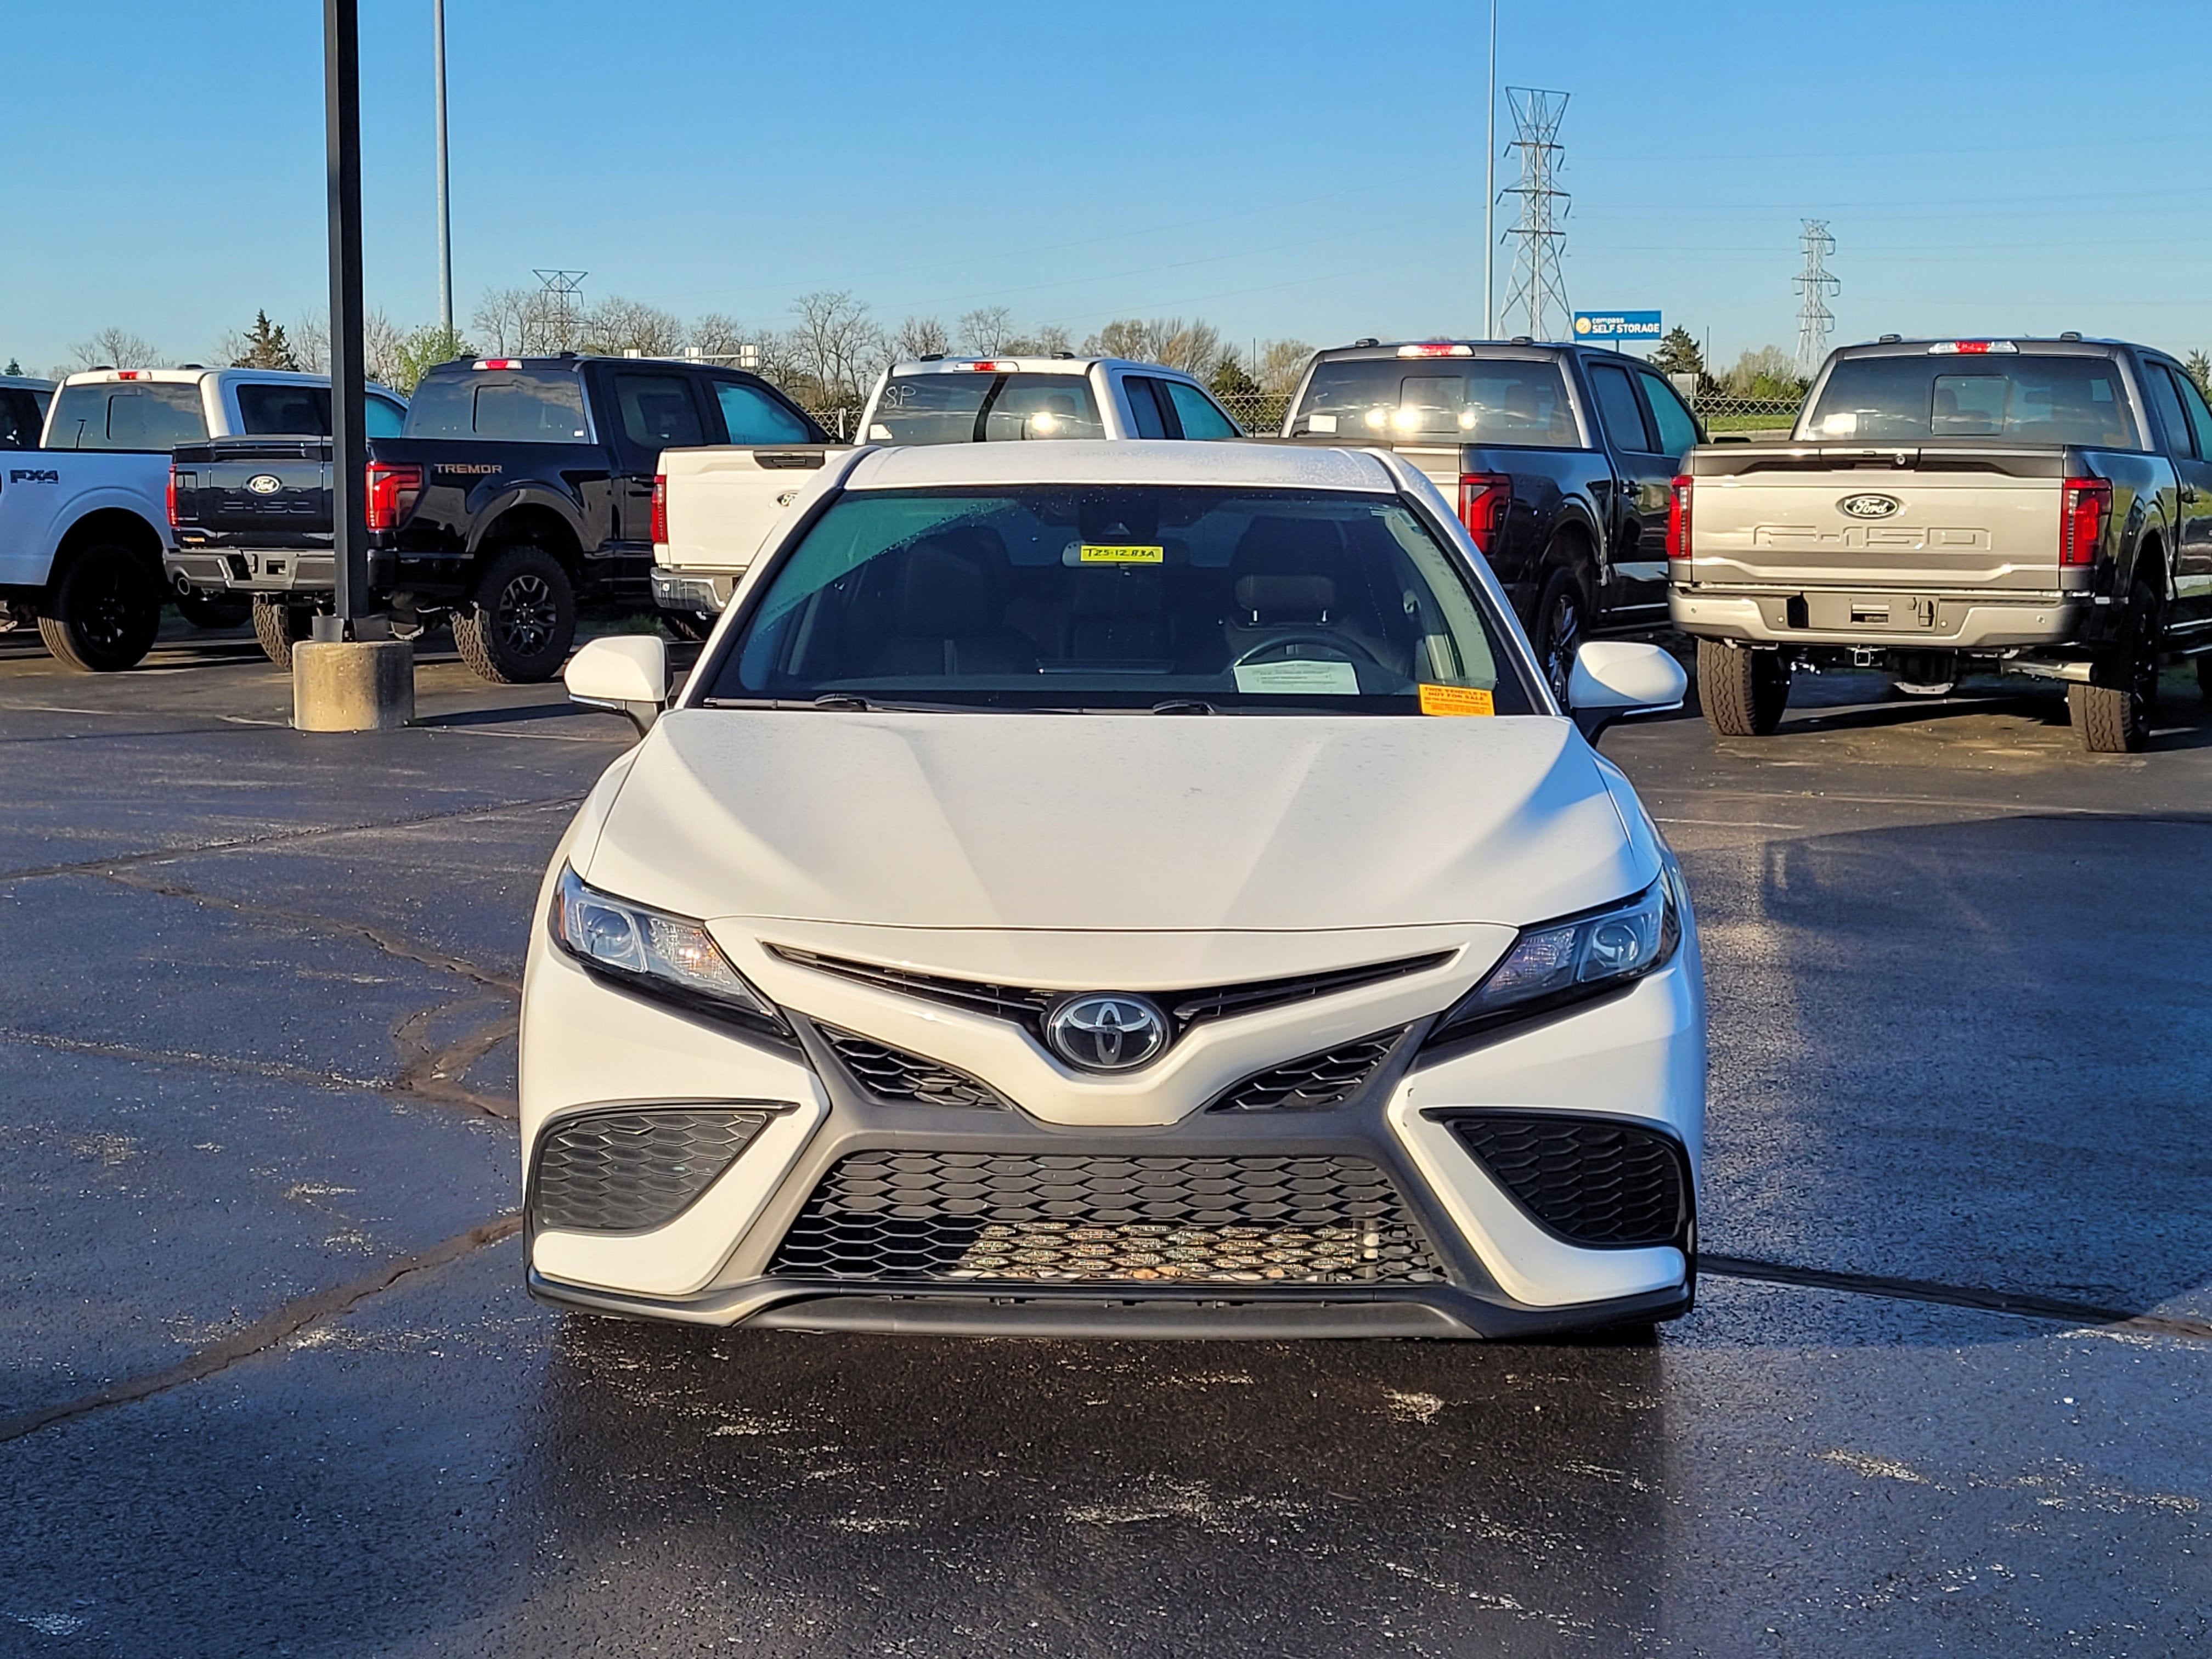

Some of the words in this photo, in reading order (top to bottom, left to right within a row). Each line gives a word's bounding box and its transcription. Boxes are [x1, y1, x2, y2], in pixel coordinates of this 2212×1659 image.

[1592, 324, 1615, 334] SELF
[1616, 324, 1660, 333] STORAGE
[434, 464, 503, 473] TREMOR
[10, 470, 58, 483] FX4
[1853, 499, 1889, 514] Ford
[1754, 525, 1991, 551] F-150
